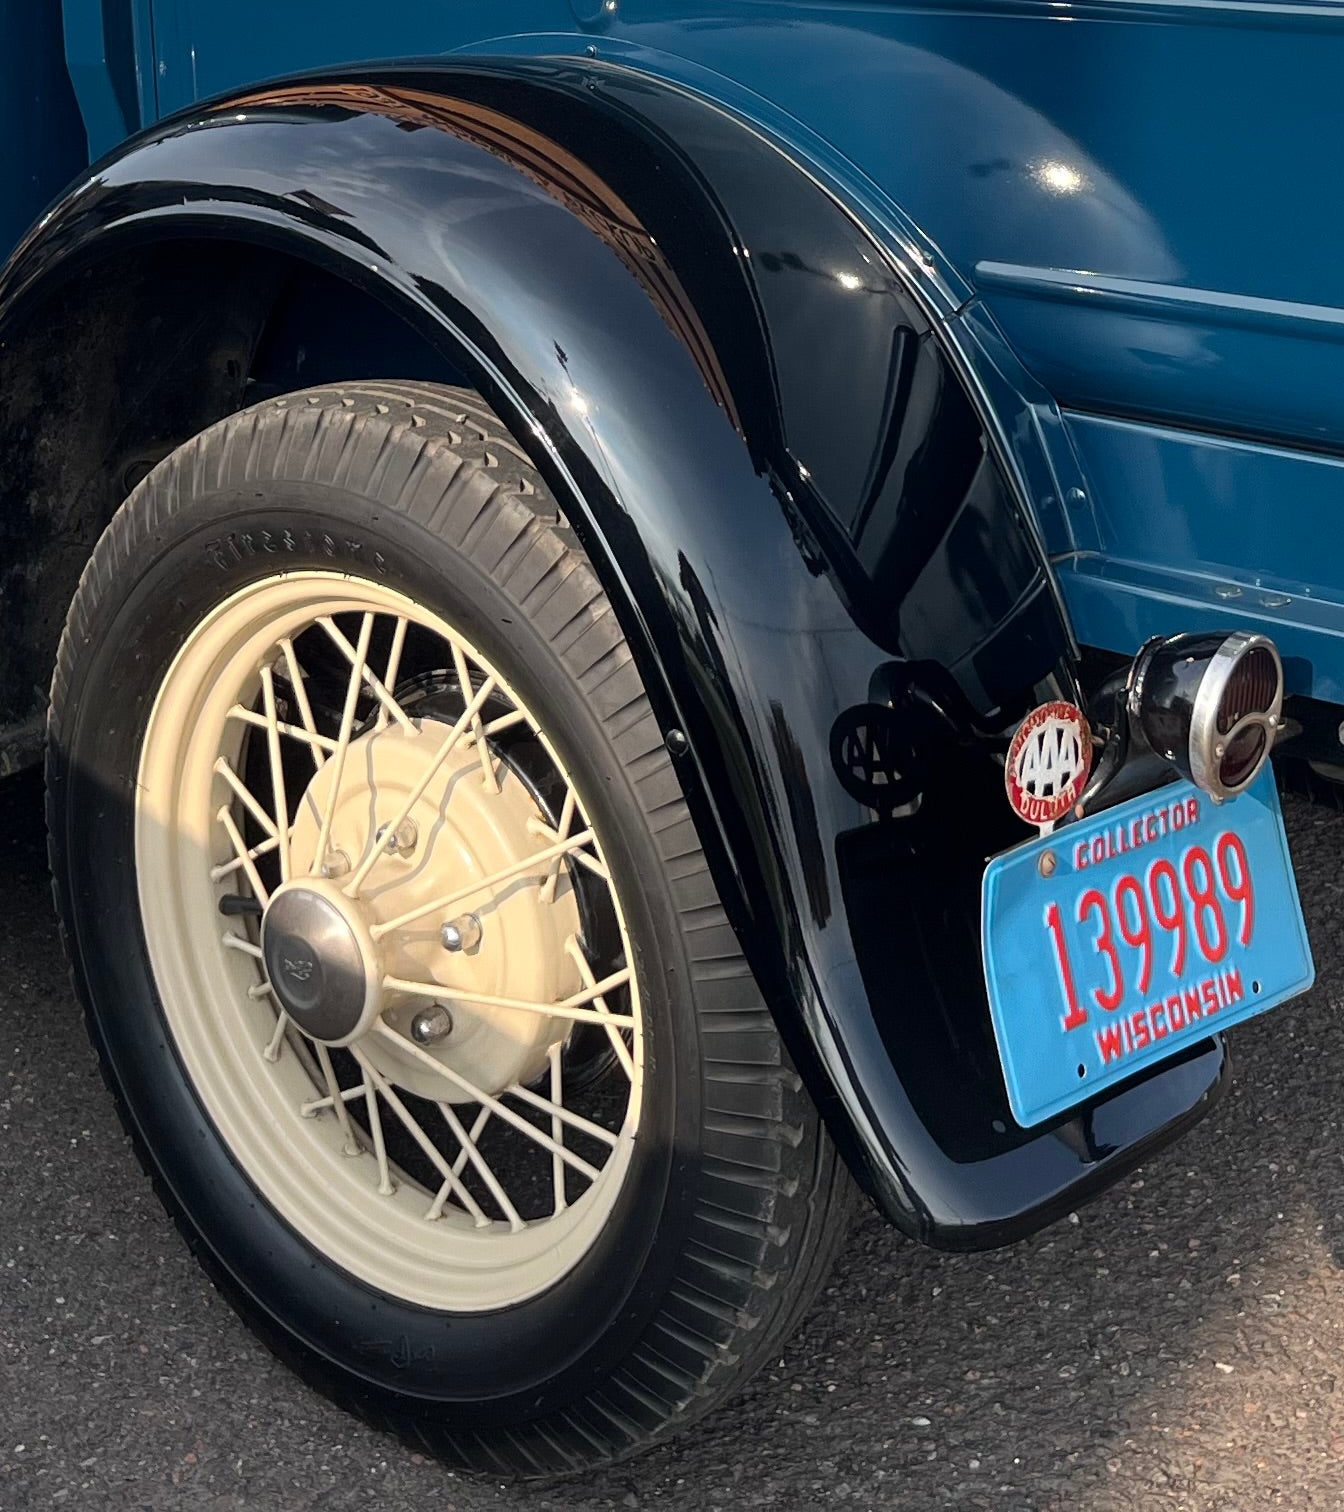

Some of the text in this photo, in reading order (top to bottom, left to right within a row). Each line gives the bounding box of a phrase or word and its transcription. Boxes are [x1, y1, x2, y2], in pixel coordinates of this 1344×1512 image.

[1019, 724, 1078, 797] AAA
[1074, 797, 1200, 871] COLLECTOR
[1044, 830, 1257, 1033] 139989
[1094, 968, 1246, 1066] WISCONSIN
